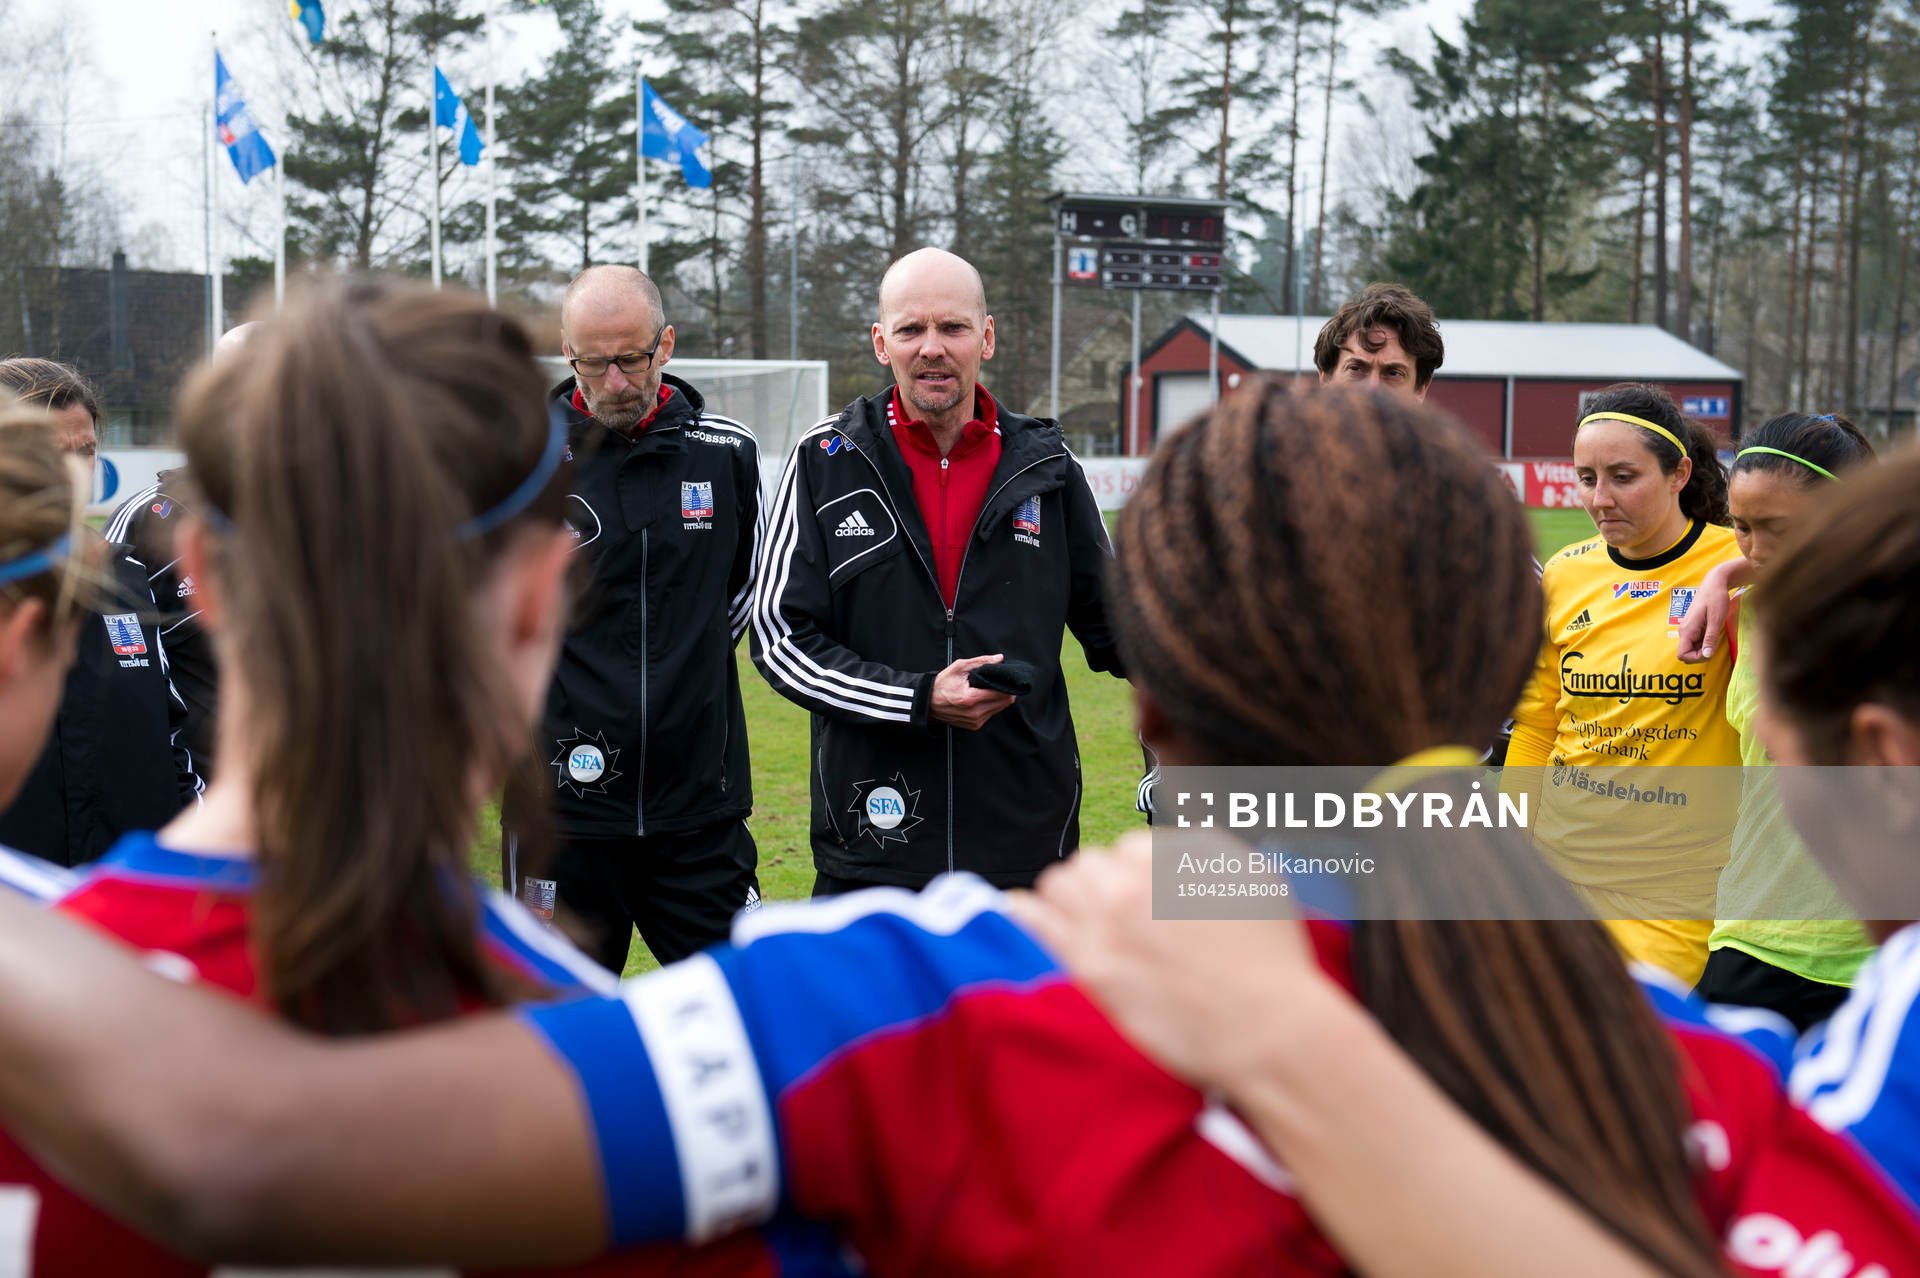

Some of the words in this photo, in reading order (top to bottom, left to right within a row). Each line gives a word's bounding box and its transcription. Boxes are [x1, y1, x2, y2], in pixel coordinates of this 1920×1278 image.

[1061, 212, 1077, 230] H
[834, 527, 875, 537] adidas
[1630, 581, 1660, 590] INTER
[1561, 651, 1703, 705] Emmaljunga
[571, 753, 603, 770] SFA
[1567, 765, 1687, 806] Hässleholm
[869, 797, 903, 815] SFA
